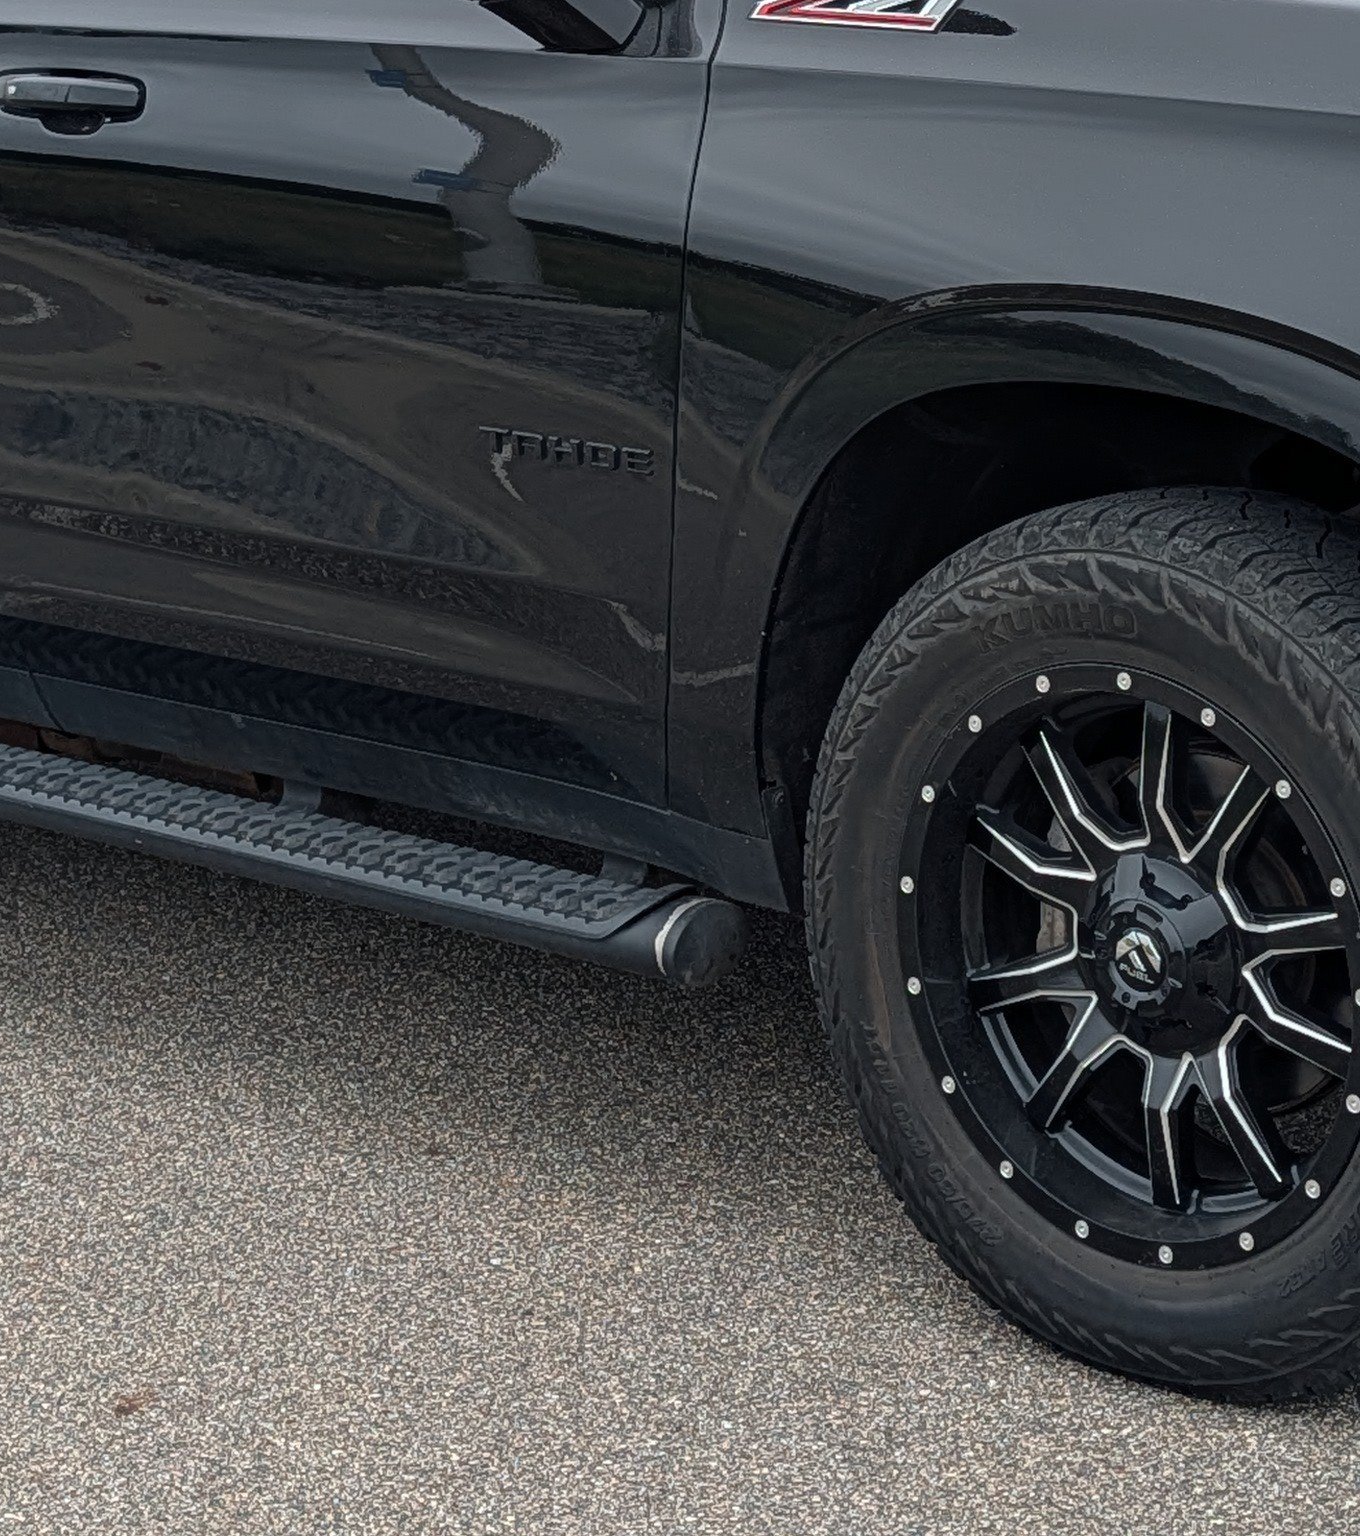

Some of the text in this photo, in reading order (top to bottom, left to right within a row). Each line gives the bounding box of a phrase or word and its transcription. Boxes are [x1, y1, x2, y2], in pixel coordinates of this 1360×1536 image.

[478, 425, 655, 477] TAHOE
[970, 603, 1138, 654] KUMHO
[1119, 963, 1155, 984] FUEL
